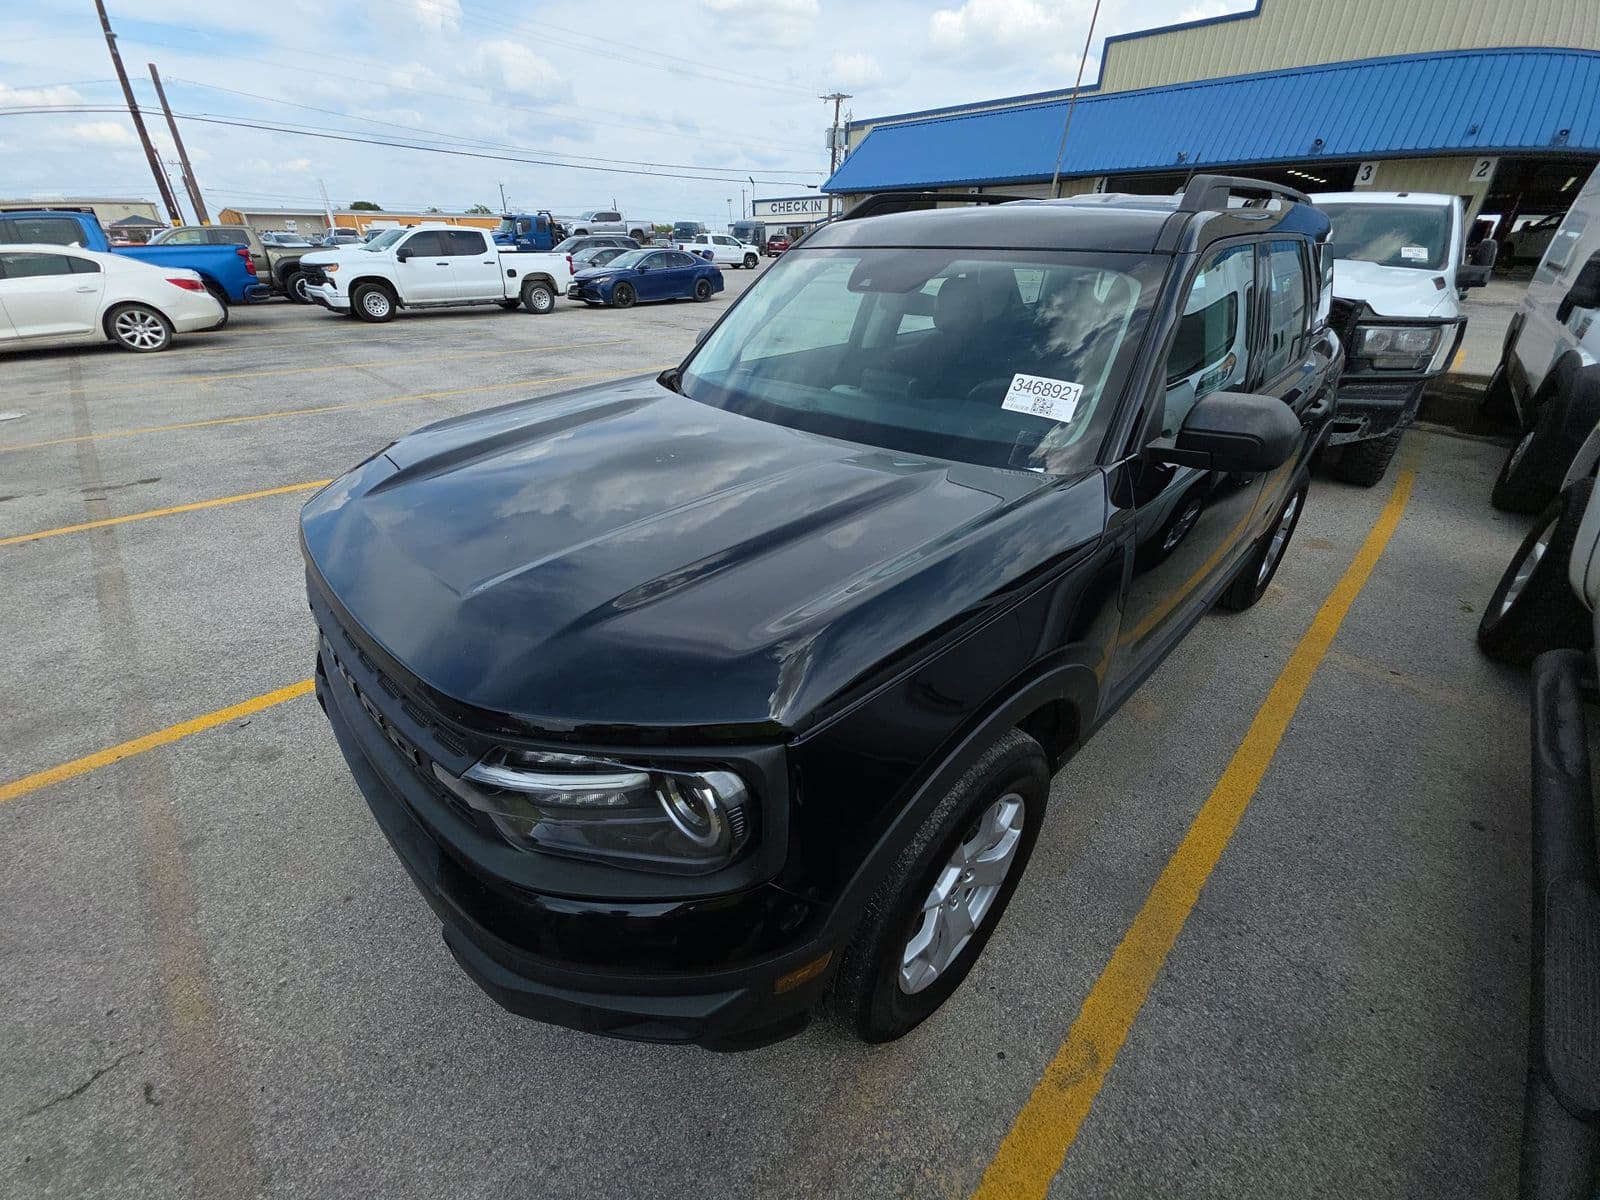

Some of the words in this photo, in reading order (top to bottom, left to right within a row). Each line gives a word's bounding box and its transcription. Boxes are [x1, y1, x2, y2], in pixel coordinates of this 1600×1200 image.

[1361, 165, 1373, 181] 3
[1476, 160, 1491, 177] 2
[770, 202, 807, 213] CHECK
[811, 200, 822, 211] IN
[1013, 377, 1080, 402] 3468921
